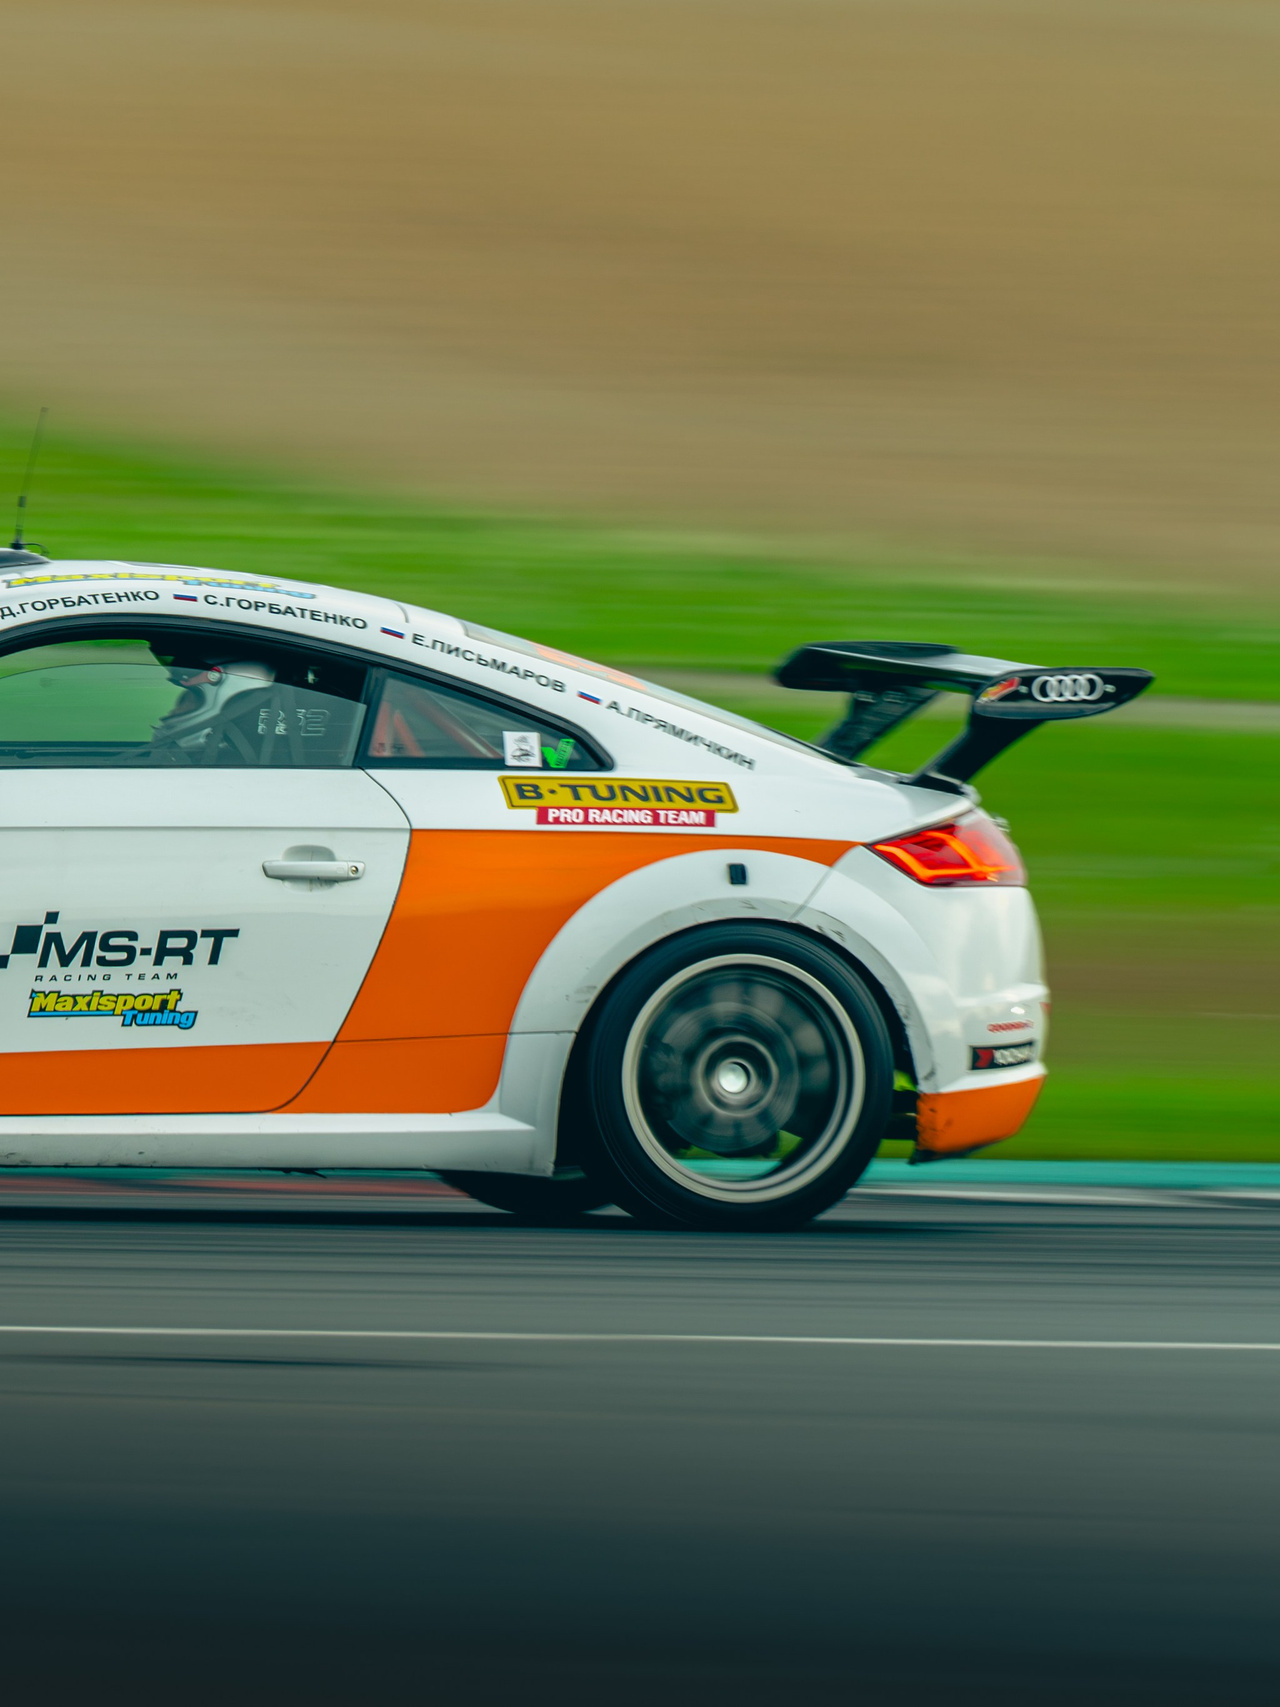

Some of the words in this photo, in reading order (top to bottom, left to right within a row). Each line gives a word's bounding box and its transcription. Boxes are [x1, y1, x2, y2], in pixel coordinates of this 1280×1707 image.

[203, 594, 369, 630] С.ГОРБАТЕНКО
[412, 632, 566, 693] Е.ПИСЬМАРОВ
[547, 808, 583, 823] PRO
[588, 809, 653, 824] RACING
[656, 809, 706, 825] TEAM
[37, 928, 240, 968] MS-RT
[34, 973, 112, 982] RACING
[125, 972, 179, 981] TEAM
[28, 989, 183, 1016] Maxisport
[121, 1010, 198, 1030] Tuning
